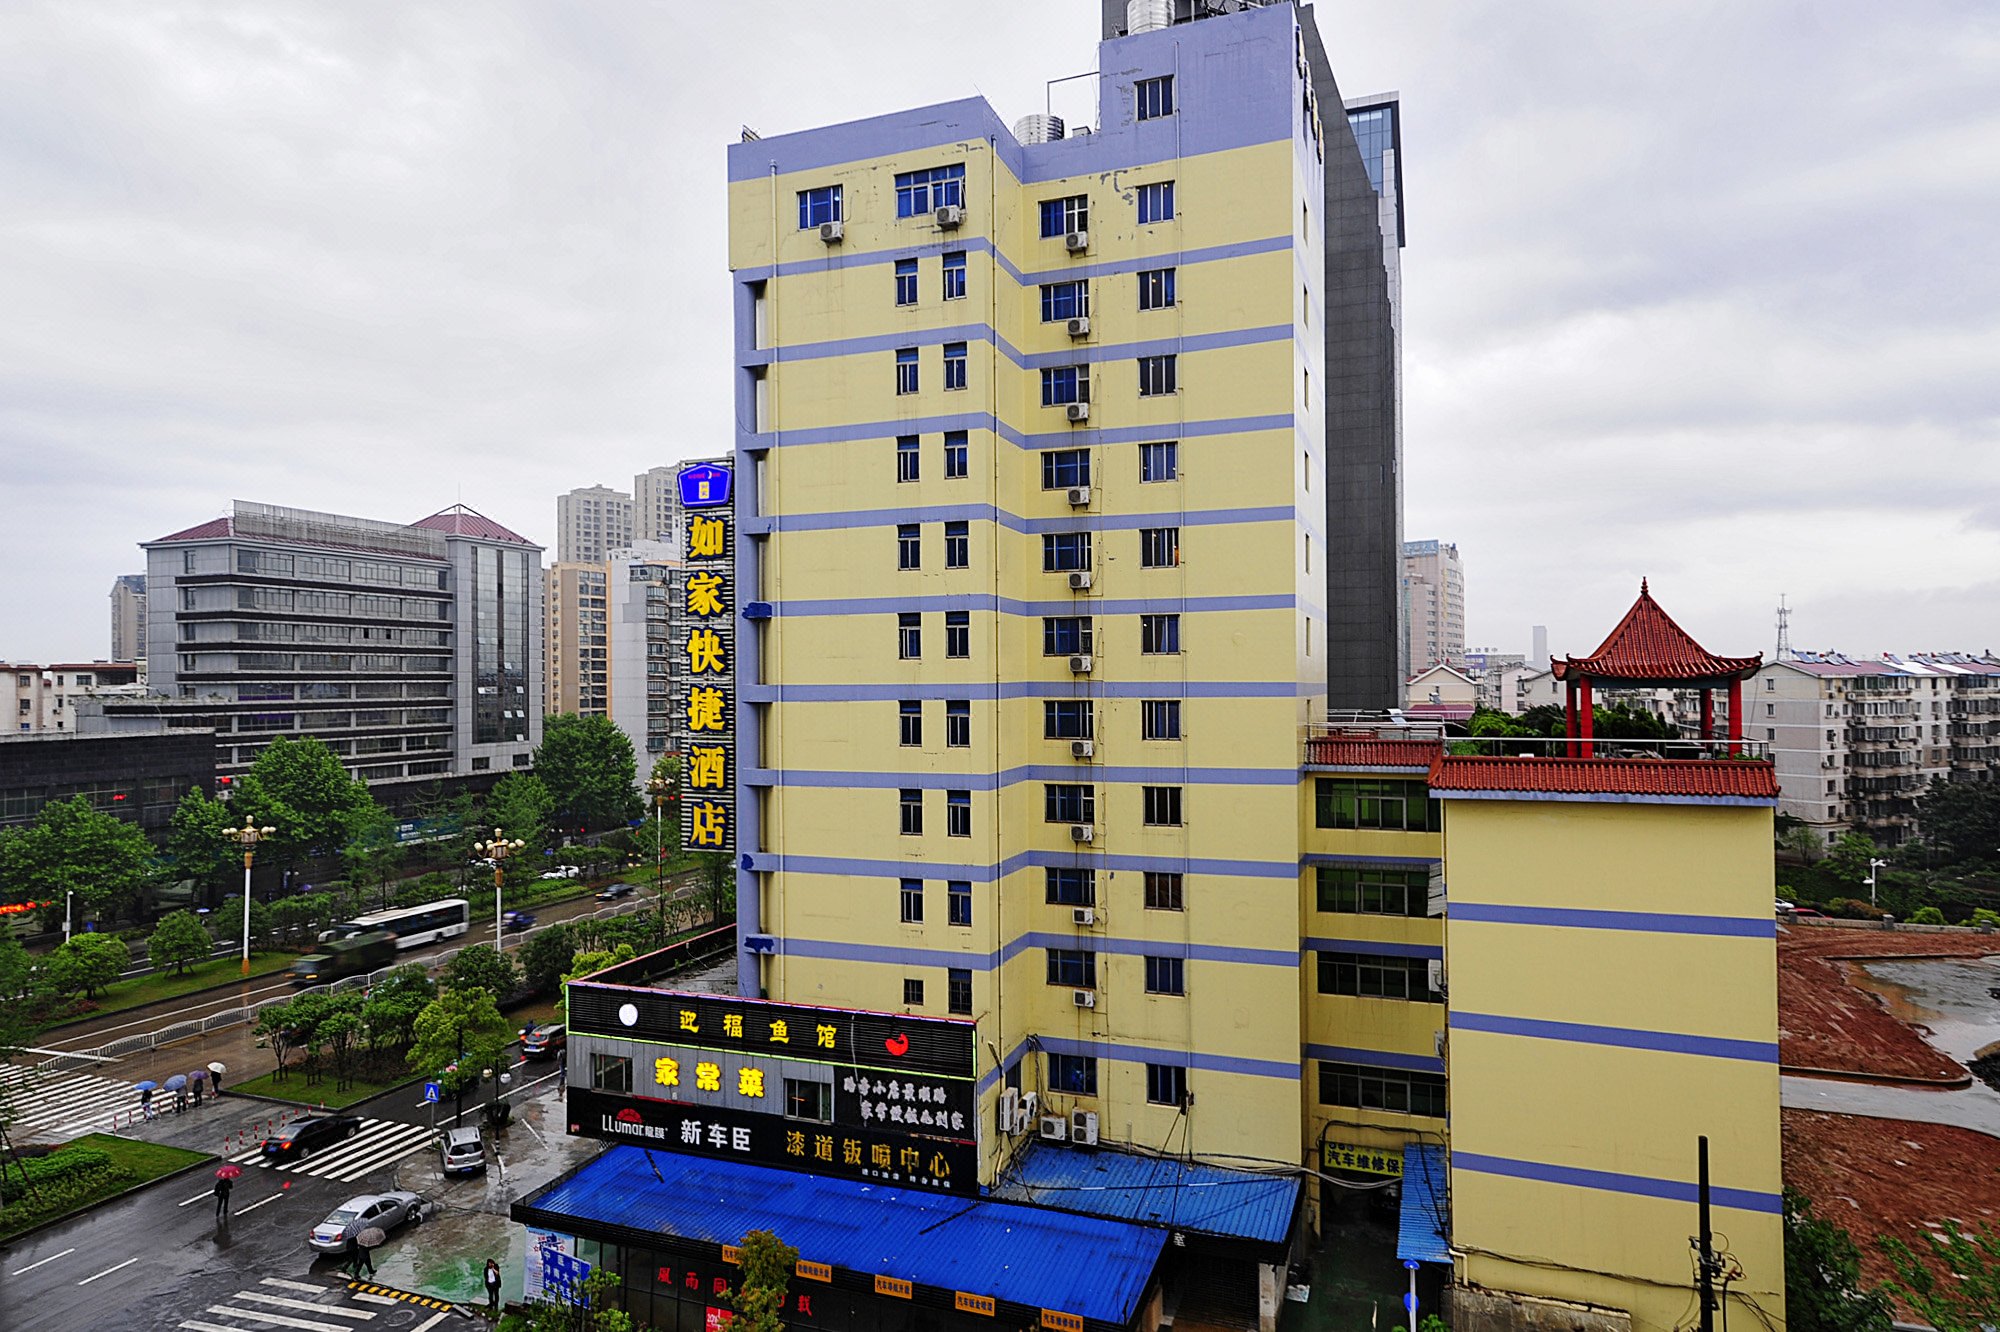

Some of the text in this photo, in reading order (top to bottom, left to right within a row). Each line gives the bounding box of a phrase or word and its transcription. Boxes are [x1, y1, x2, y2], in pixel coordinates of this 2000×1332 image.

[686, 513, 726, 847] 如家快捷酒店
[679, 1009, 837, 1049] 迎福鱼馆
[654, 1056, 765, 1099] 家常菜
[679, 1118, 752, 1152] 新车臣
[785, 1129, 952, 1178] 漆道钣喷中心
[1327, 1149, 1404, 1174] 汽车维修保
